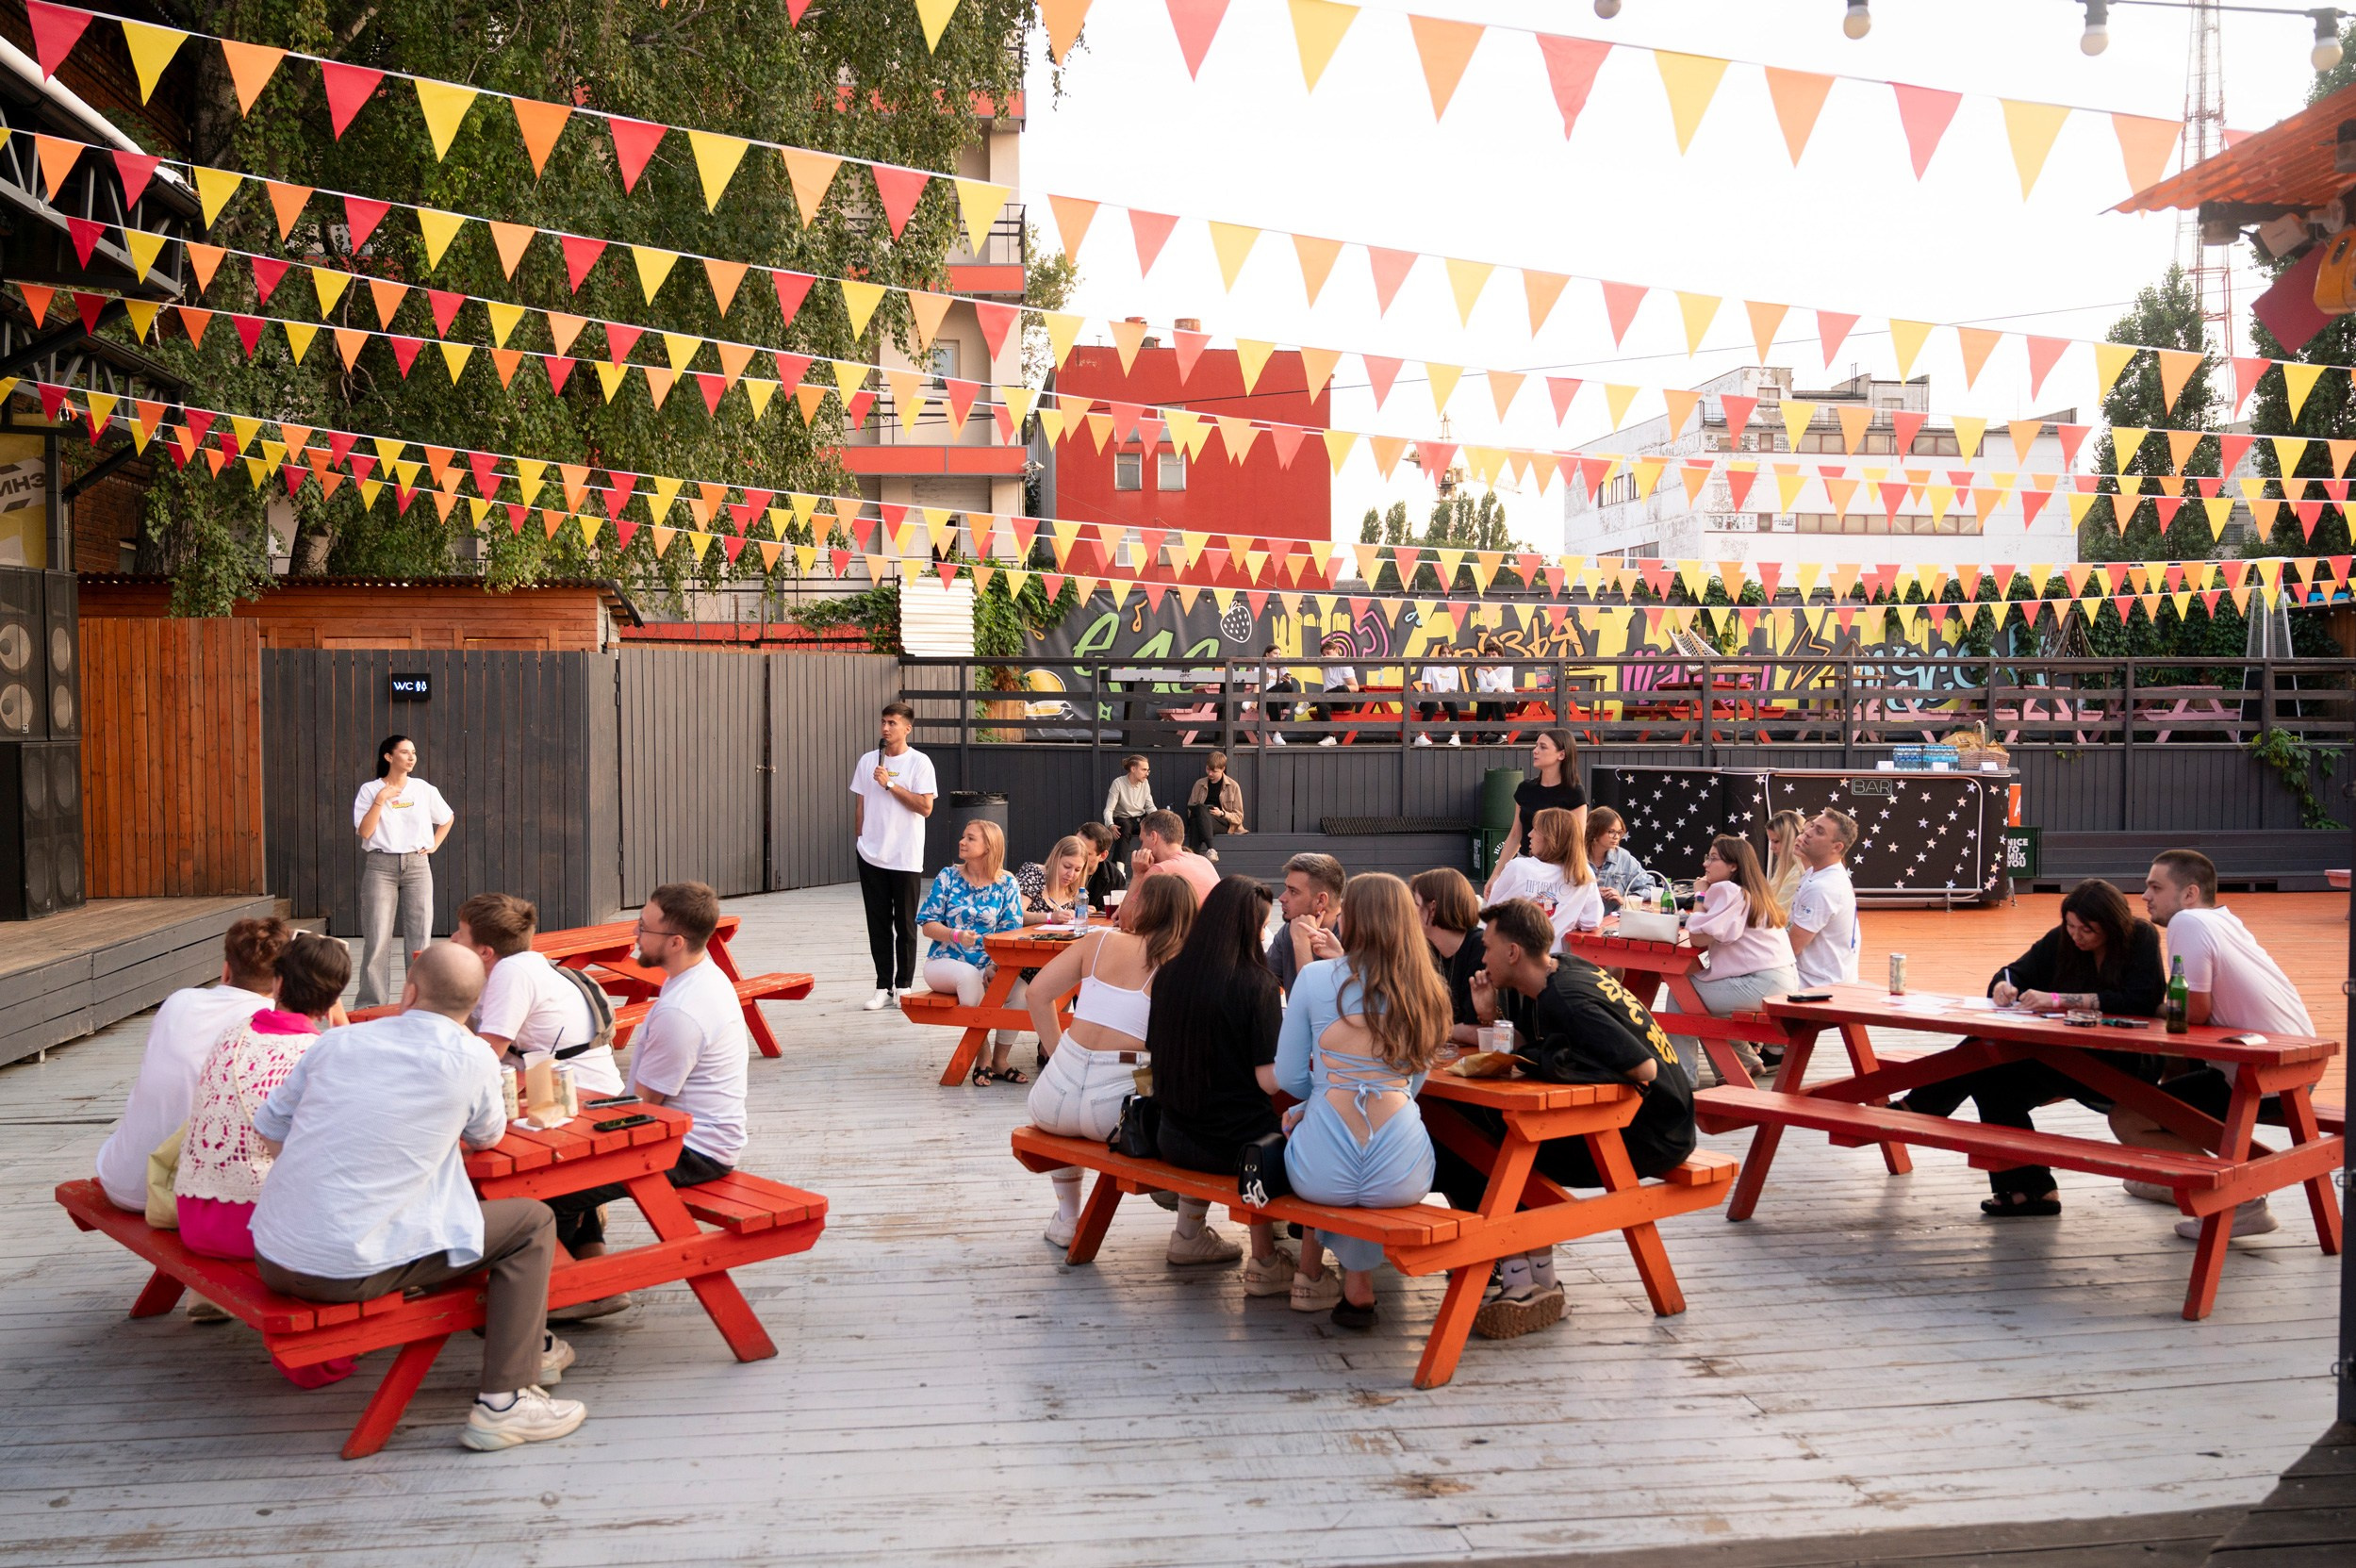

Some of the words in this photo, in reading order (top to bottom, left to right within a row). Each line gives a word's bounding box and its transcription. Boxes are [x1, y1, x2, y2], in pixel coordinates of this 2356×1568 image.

[392, 681, 414, 691] WC
[1853, 780, 1891, 794] BAR
[2007, 838, 2029, 847] NICE
[2007, 859, 2026, 867] YOU
